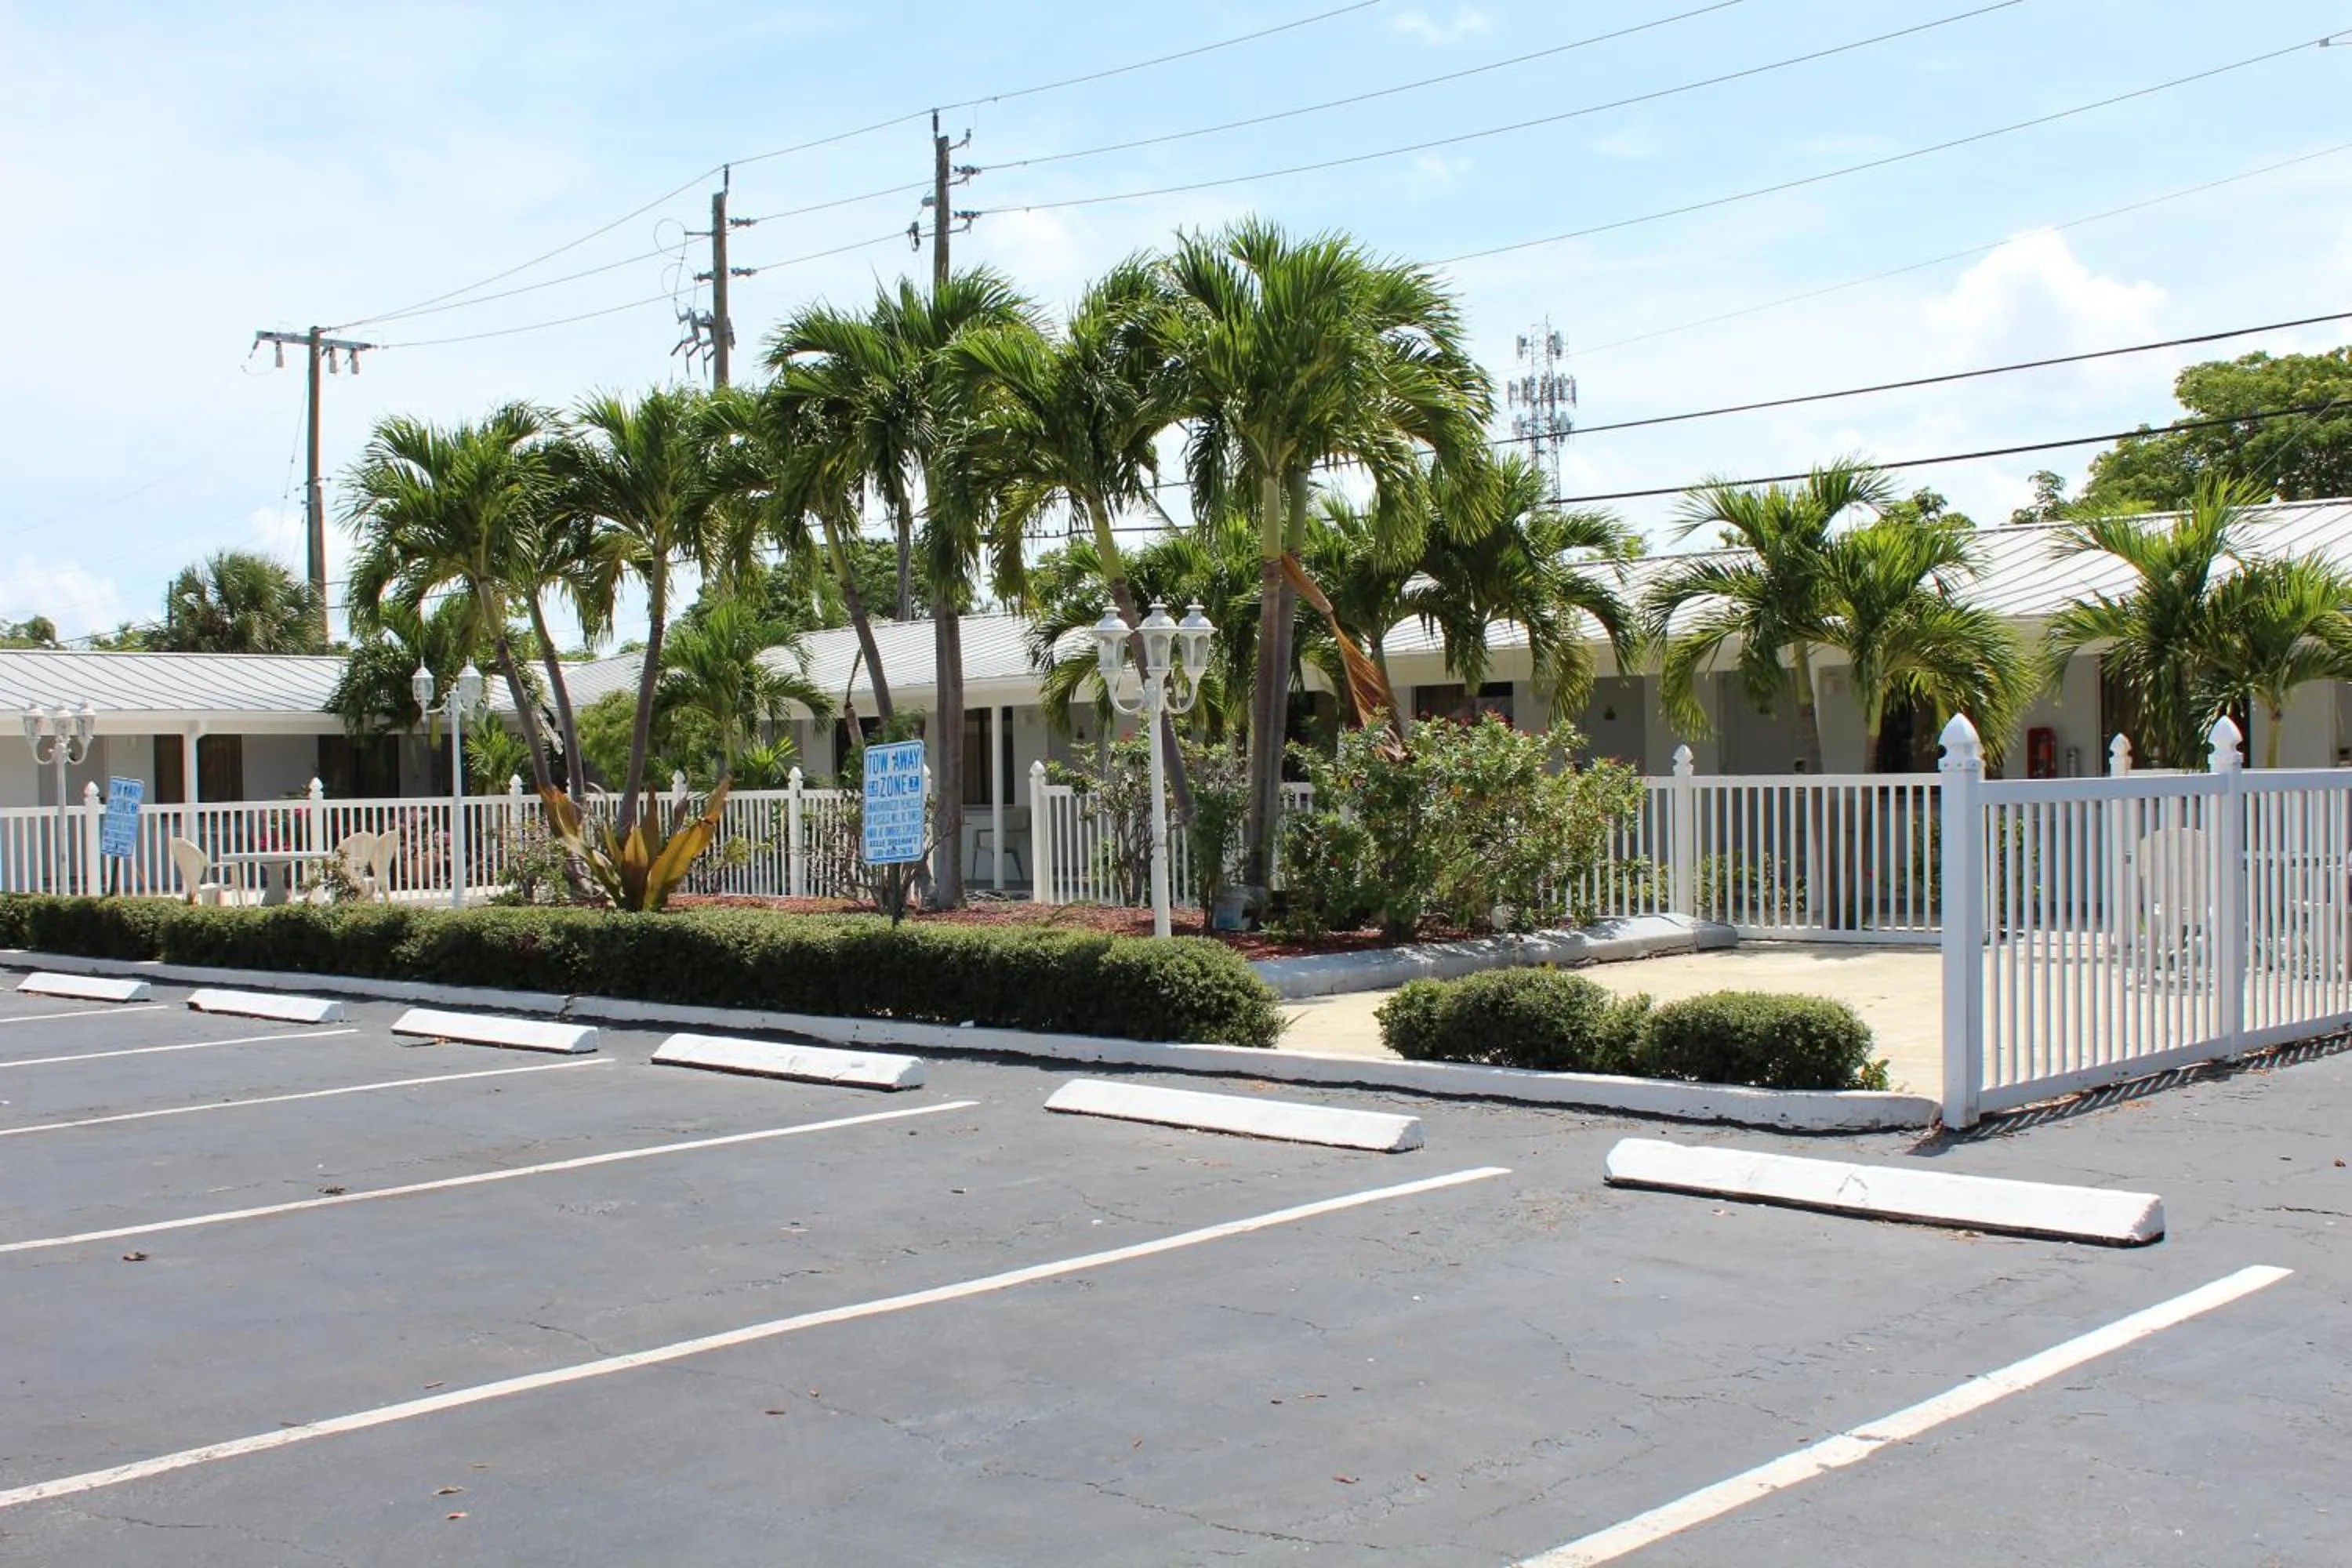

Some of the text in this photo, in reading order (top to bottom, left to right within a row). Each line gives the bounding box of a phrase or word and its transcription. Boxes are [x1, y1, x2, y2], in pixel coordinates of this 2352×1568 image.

[868, 749, 920, 775] TOW AWAY
[880, 775, 907, 797] ZONE
